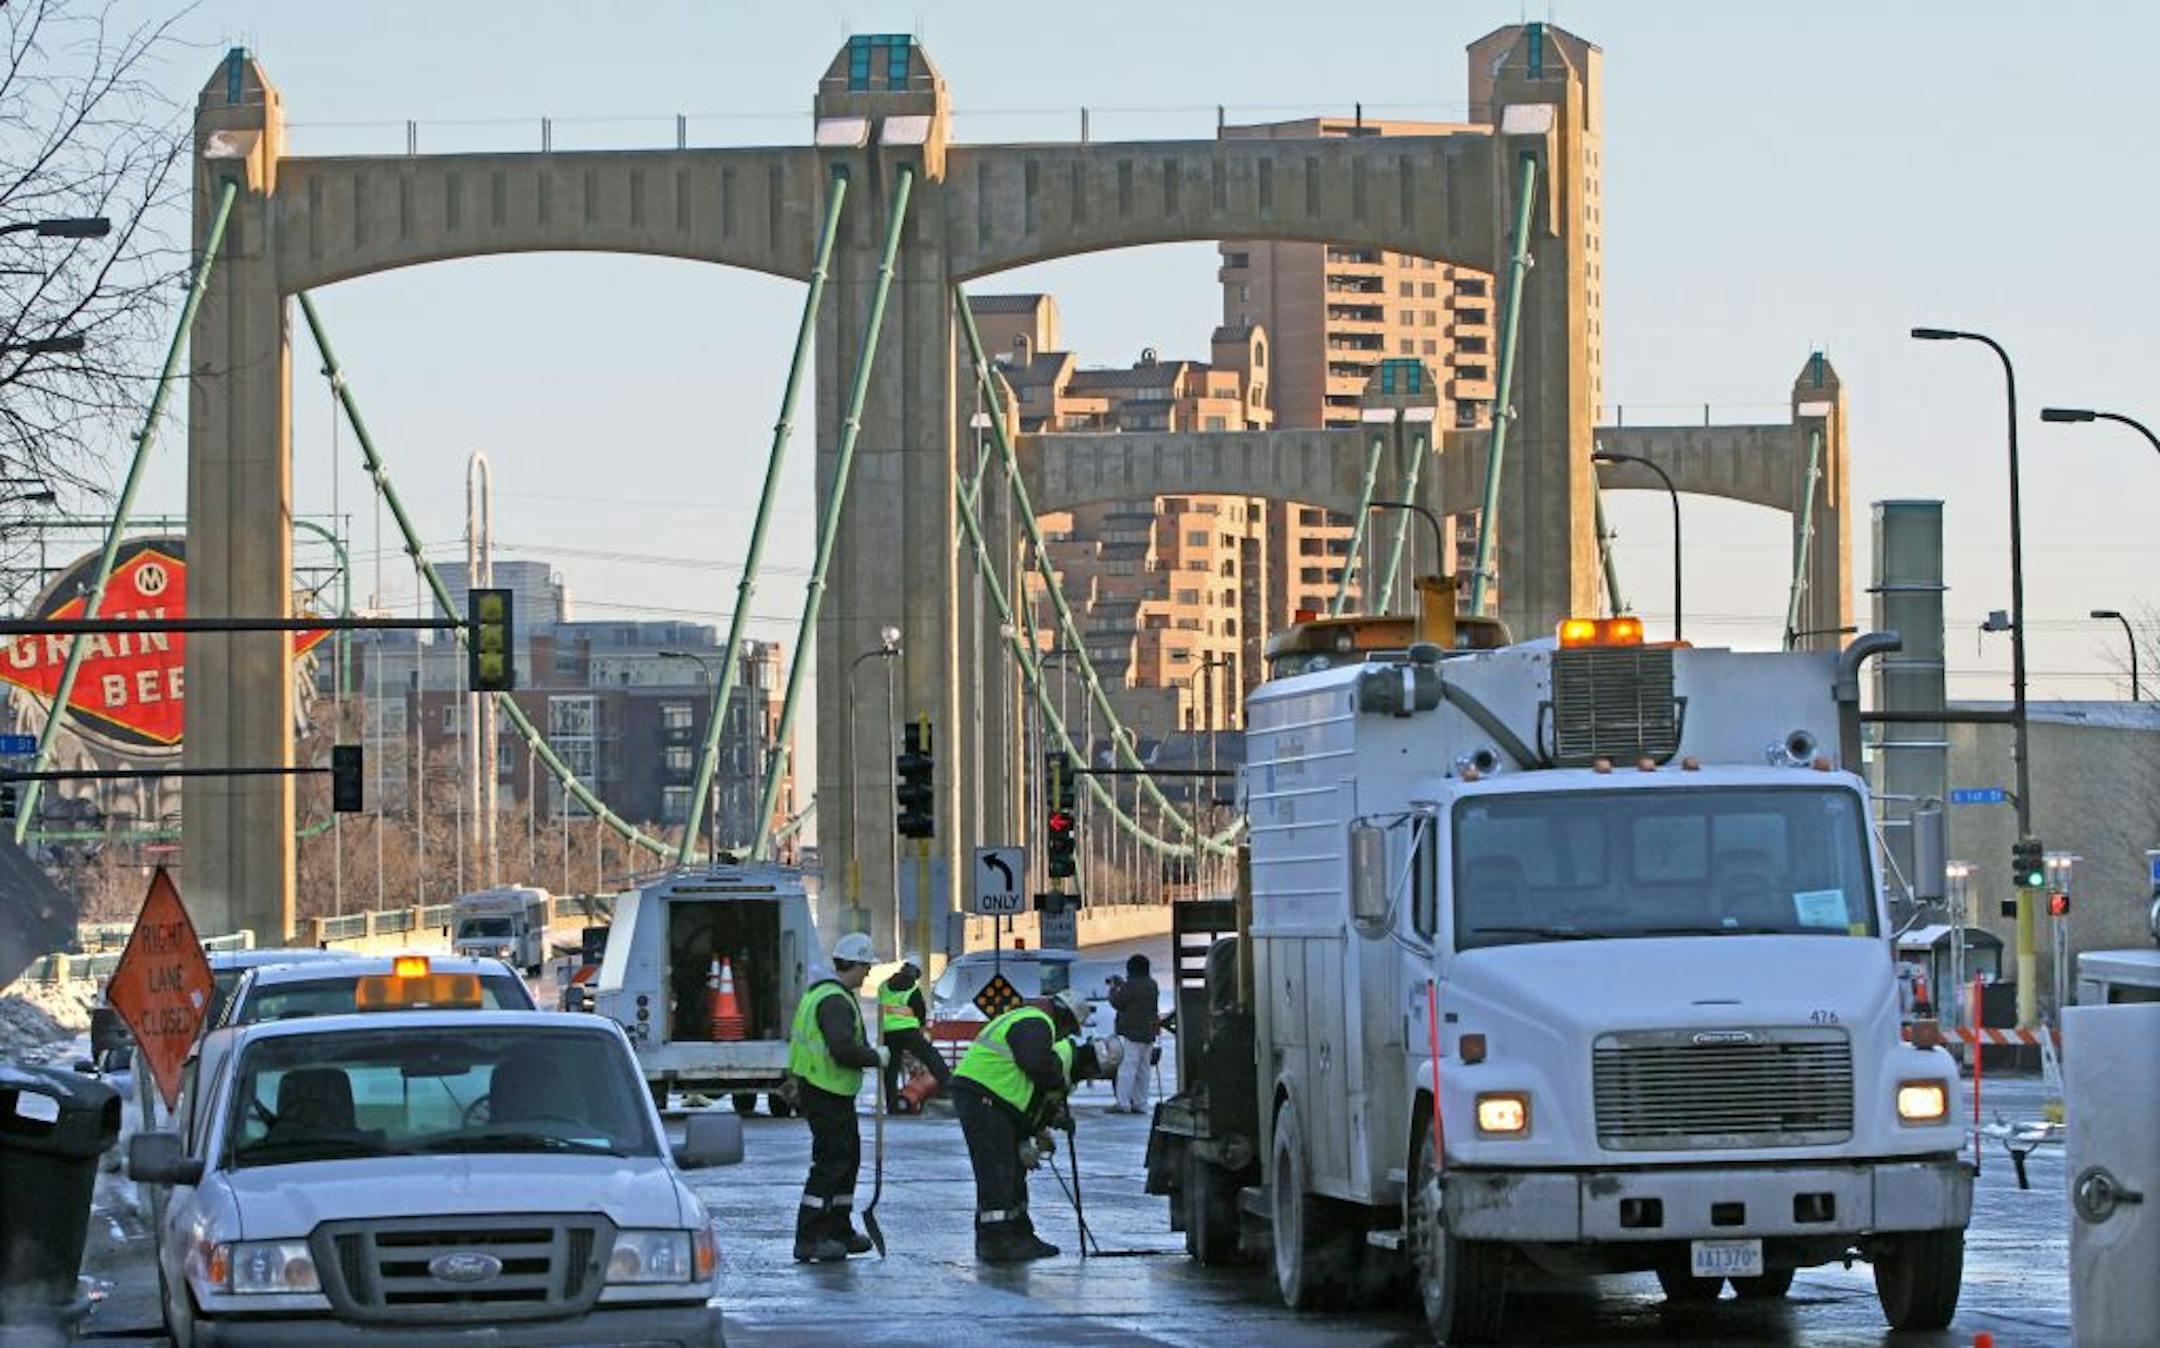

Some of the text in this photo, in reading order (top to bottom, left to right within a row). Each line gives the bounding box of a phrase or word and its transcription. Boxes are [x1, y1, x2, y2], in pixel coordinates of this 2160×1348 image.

[8, 607, 170, 670] GRAIN
[982, 895, 1019, 910] ONLY
[142, 922, 183, 950] RIGHT
[149, 963, 184, 993] LANE
[142, 1006, 191, 1036] CLOSED
[1810, 1010, 1839, 1025] 476
